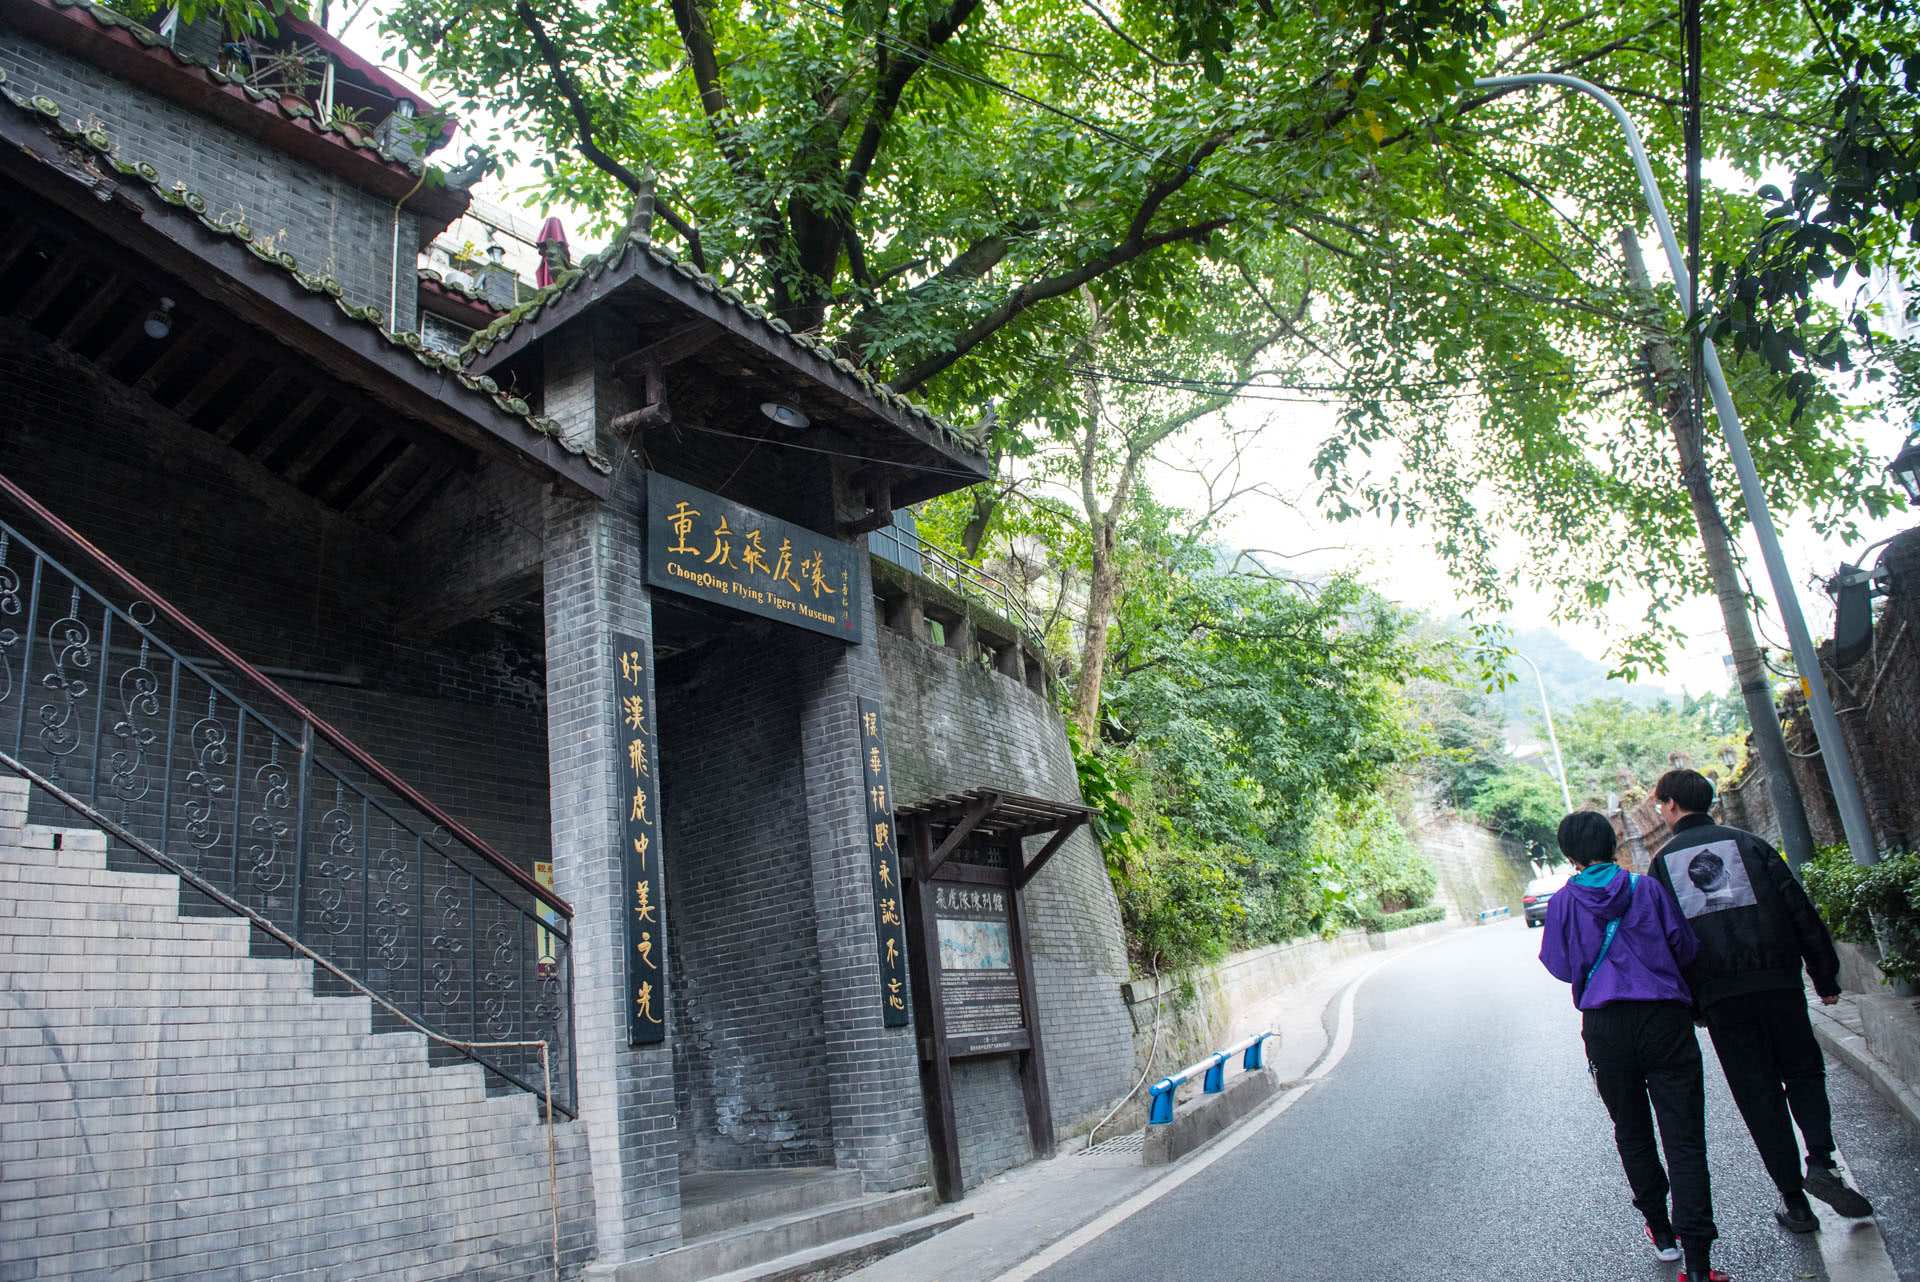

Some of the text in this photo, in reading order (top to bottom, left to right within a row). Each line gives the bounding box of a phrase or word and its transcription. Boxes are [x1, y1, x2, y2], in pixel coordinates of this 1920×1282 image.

[667, 562, 836, 624] ChongQing Flying Tigers Museum
[620, 650, 662, 1024] 好漢飛虎中美之光
[862, 711, 905, 1011] 援華抗戰永誌不忘
